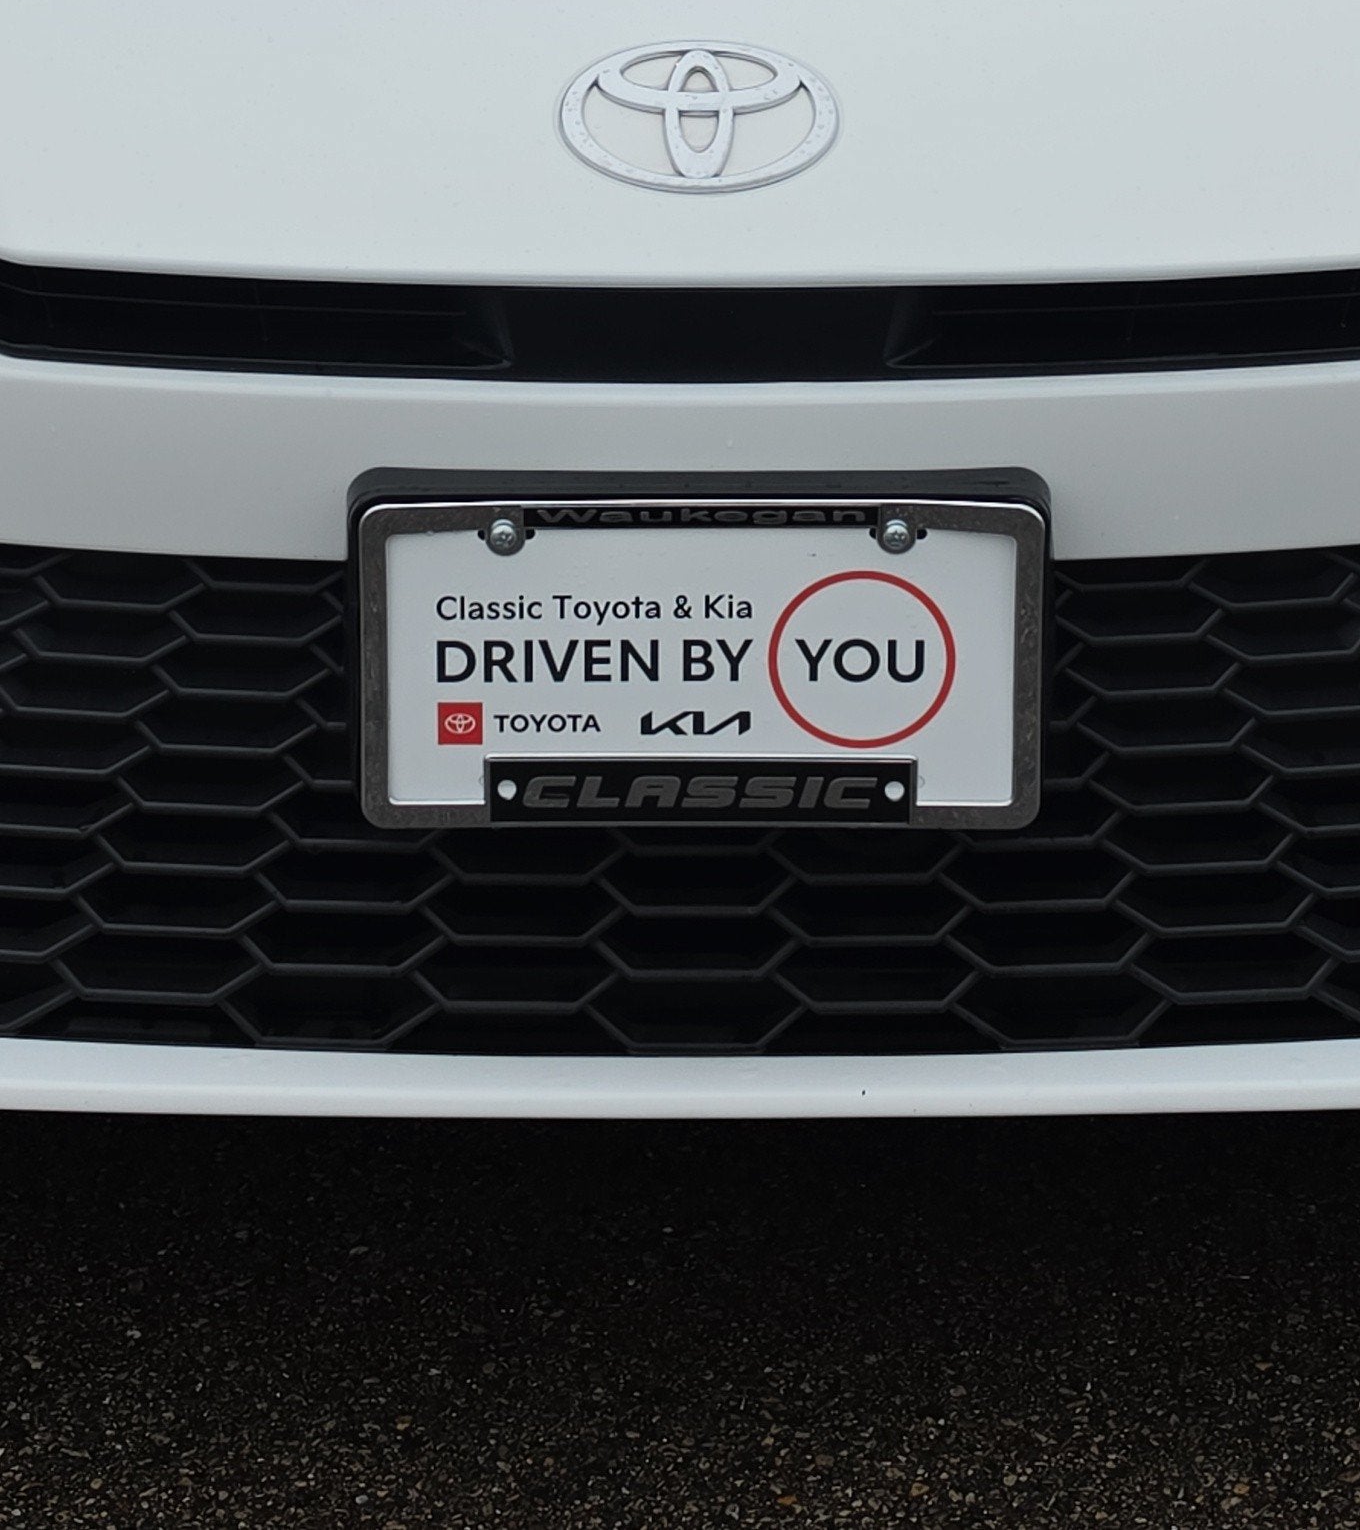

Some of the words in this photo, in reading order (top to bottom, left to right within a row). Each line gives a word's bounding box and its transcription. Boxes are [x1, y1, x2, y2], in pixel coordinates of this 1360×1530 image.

[436, 595, 542, 620] Classic
[552, 595, 661, 626] Toyota
[673, 595, 693, 619] &
[704, 594, 753, 619] Kia
[436, 639, 659, 683] DRIVEN
[682, 638, 754, 682] BY
[795, 638, 926, 683] YOU
[493, 713, 601, 733] TOYOTA
[640, 711, 751, 735] KIA
[522, 775, 878, 809] CLASSIC
